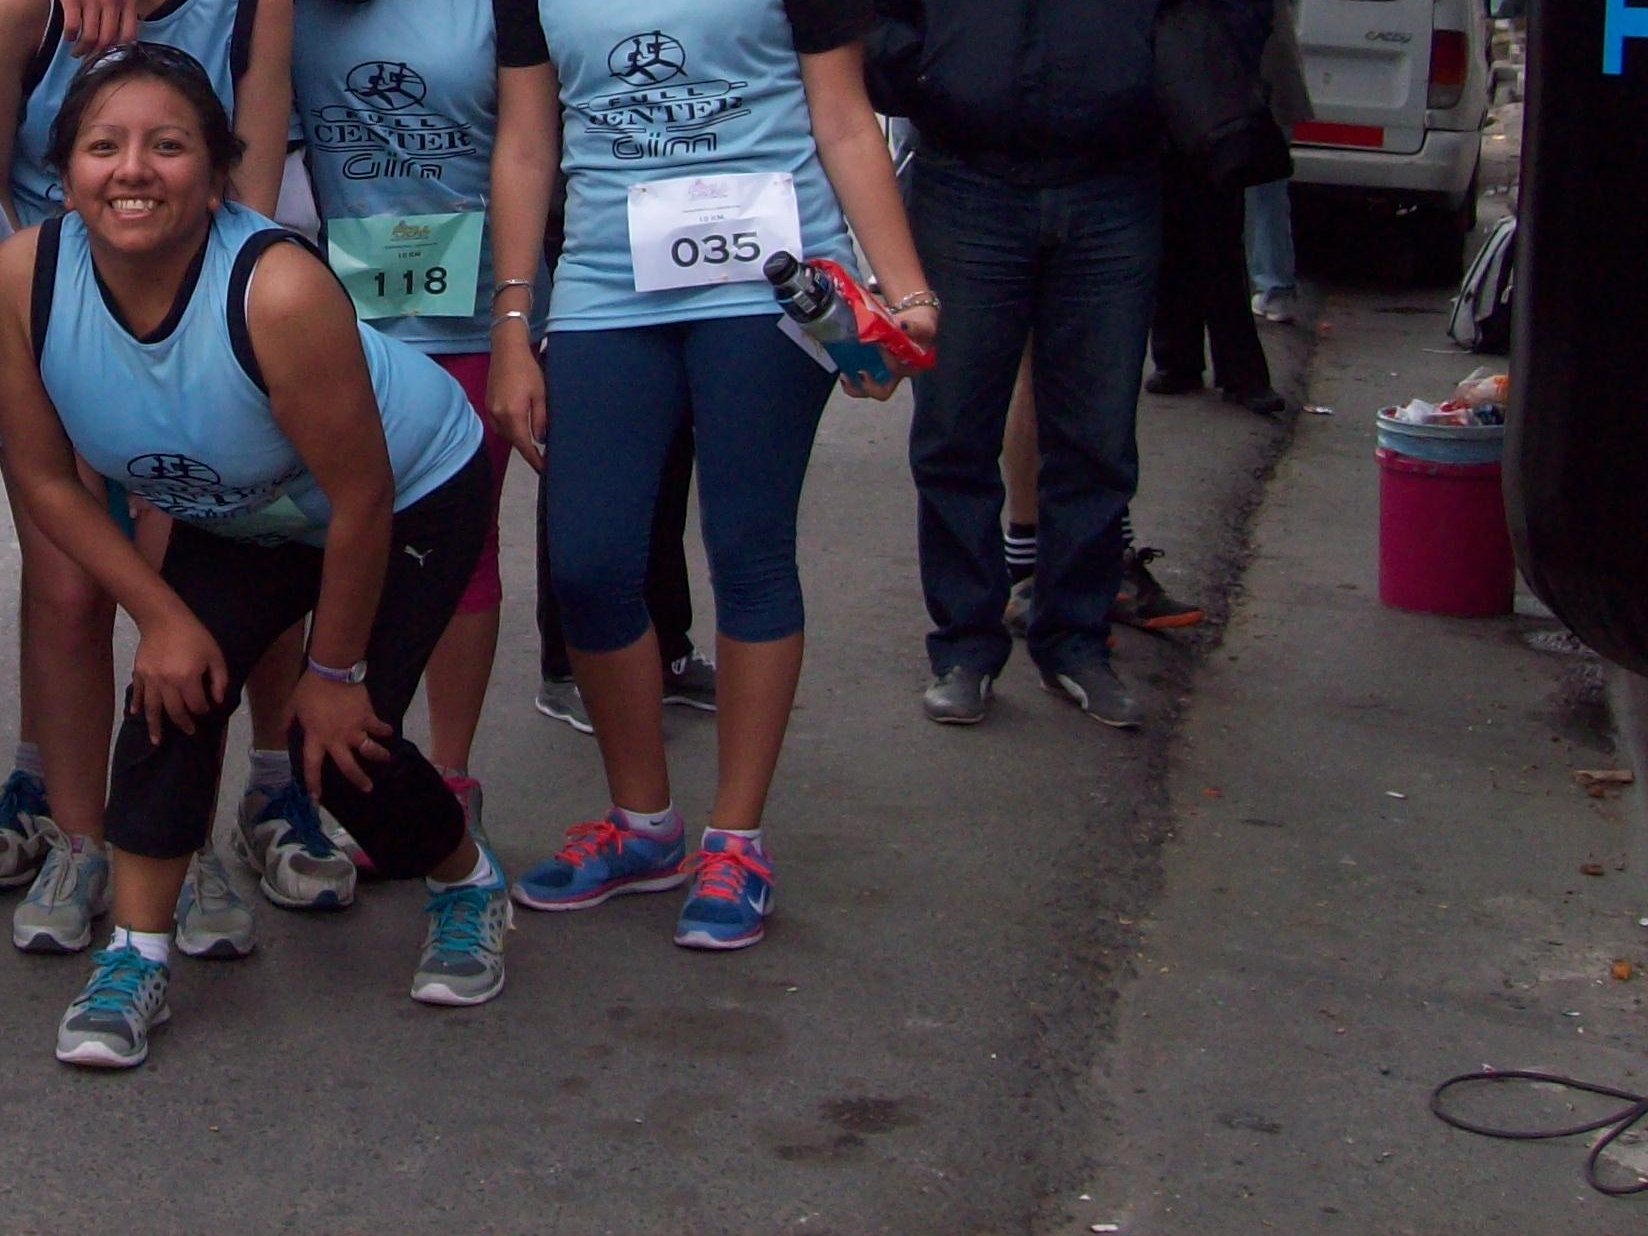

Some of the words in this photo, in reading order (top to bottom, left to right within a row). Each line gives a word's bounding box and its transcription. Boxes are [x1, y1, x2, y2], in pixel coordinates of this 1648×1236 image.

[608, 87, 705, 107] FULL
[314, 124, 472, 151] CENTER
[671, 231, 761, 268] 035
[373, 266, 448, 298] 118
